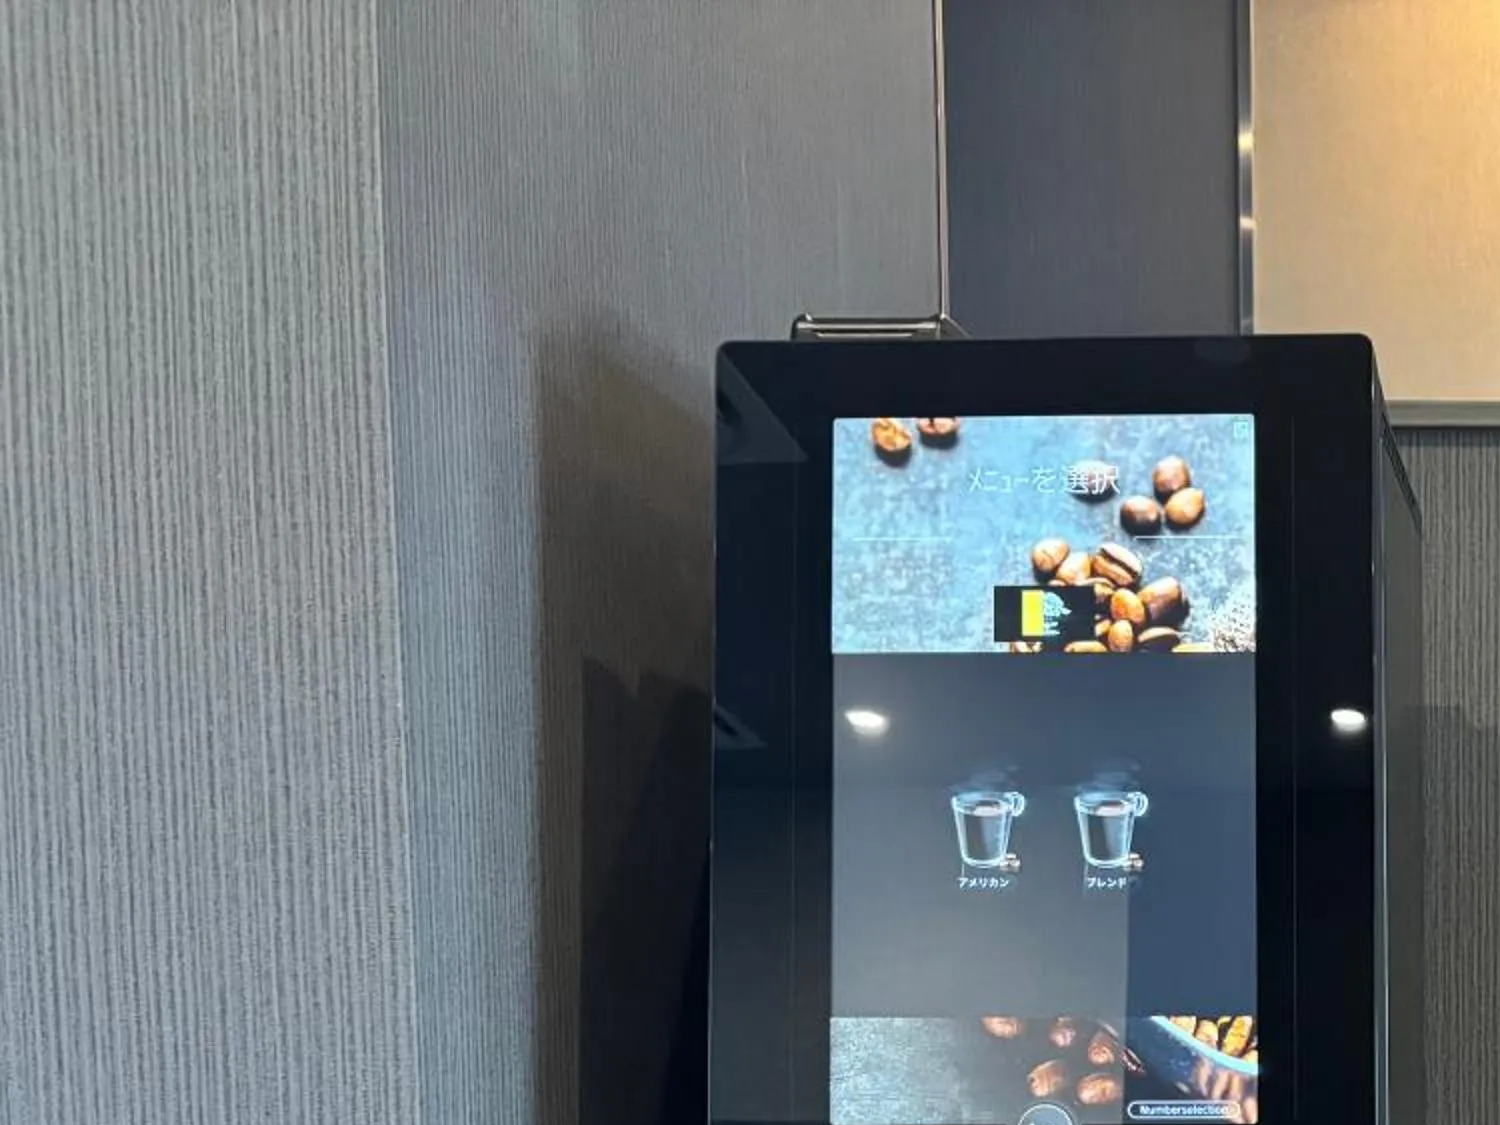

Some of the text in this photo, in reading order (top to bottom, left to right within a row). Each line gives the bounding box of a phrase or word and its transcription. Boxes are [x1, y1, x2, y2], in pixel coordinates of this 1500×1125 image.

[968, 464, 1121, 495] メニューを選択
[957, 876, 1010, 889] アメリカン
[1086, 876, 1127, 889] ブレンド
